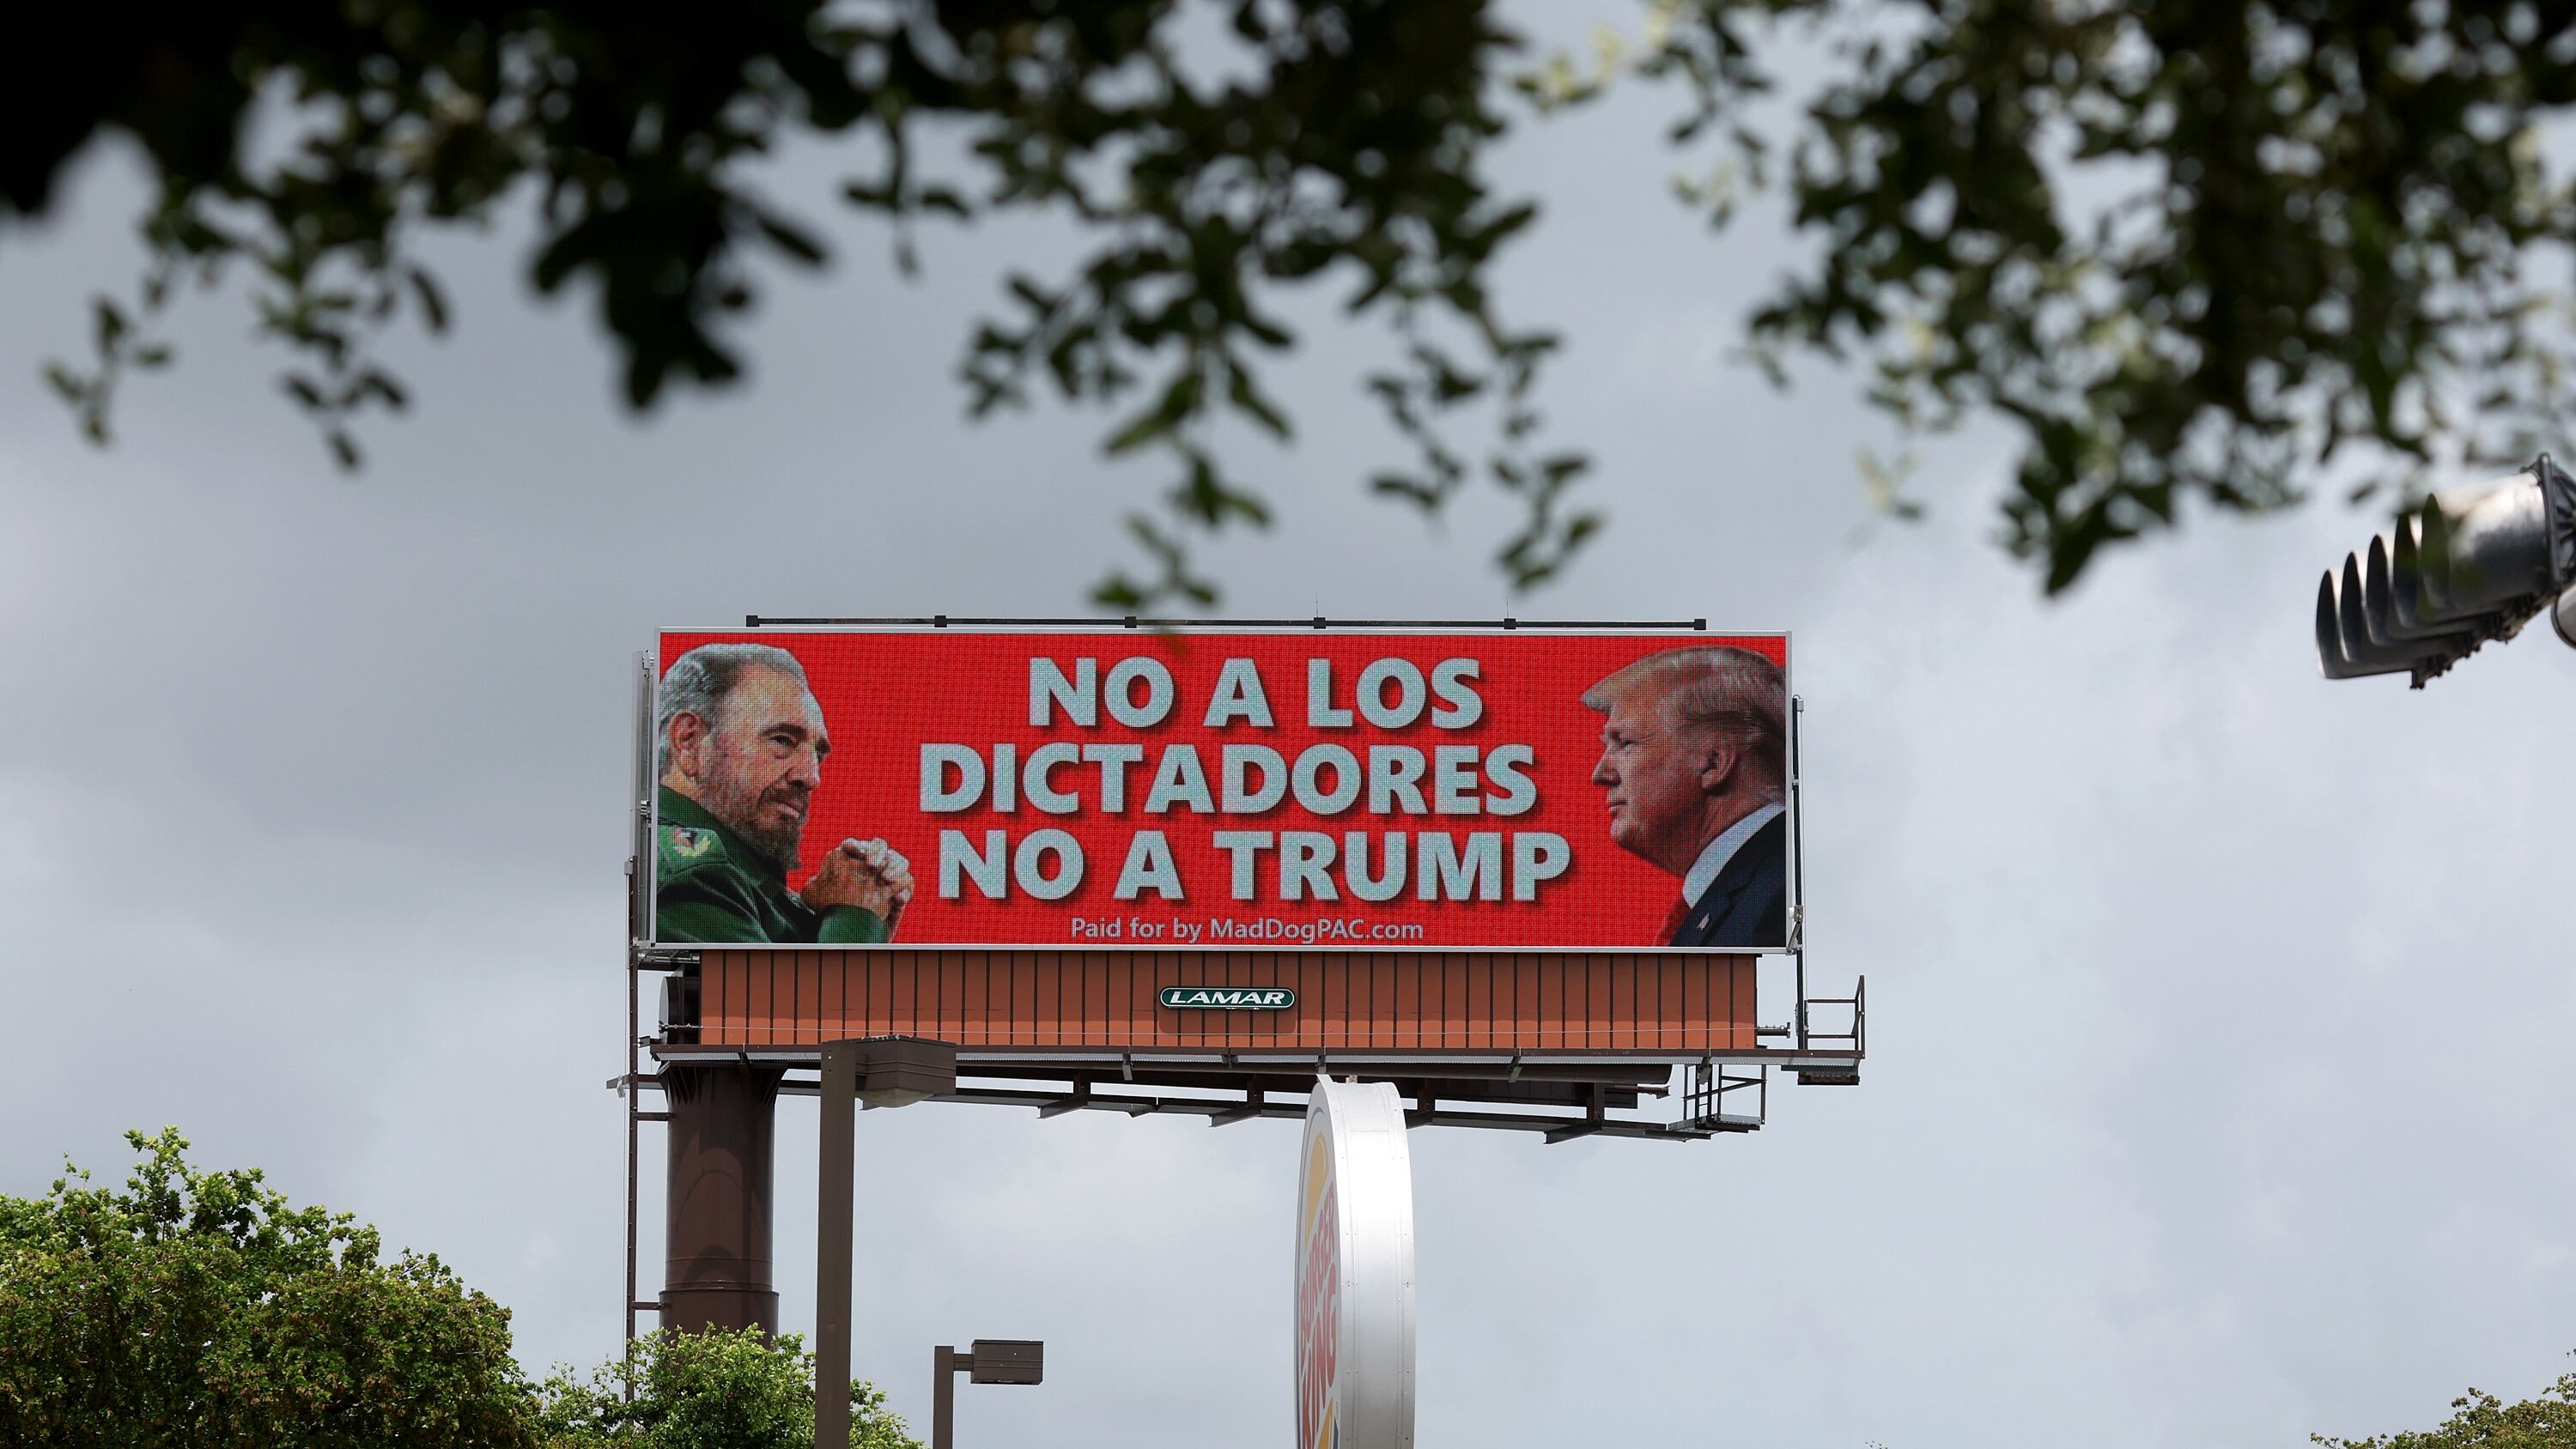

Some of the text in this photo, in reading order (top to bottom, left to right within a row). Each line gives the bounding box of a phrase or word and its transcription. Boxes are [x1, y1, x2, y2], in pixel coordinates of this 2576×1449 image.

[1030, 657, 1483, 729] NO A LOS
[919, 742, 1537, 815] DICTADORES
[938, 828, 1571, 902] NO A TRUMP
[1071, 918, 1424, 943] Paid for by MadDogPAC.com
[1170, 991, 1285, 1004] LAMAR
[1300, 1180, 1335, 1376] BURGER
[1302, 1262, 1337, 1449] KING
